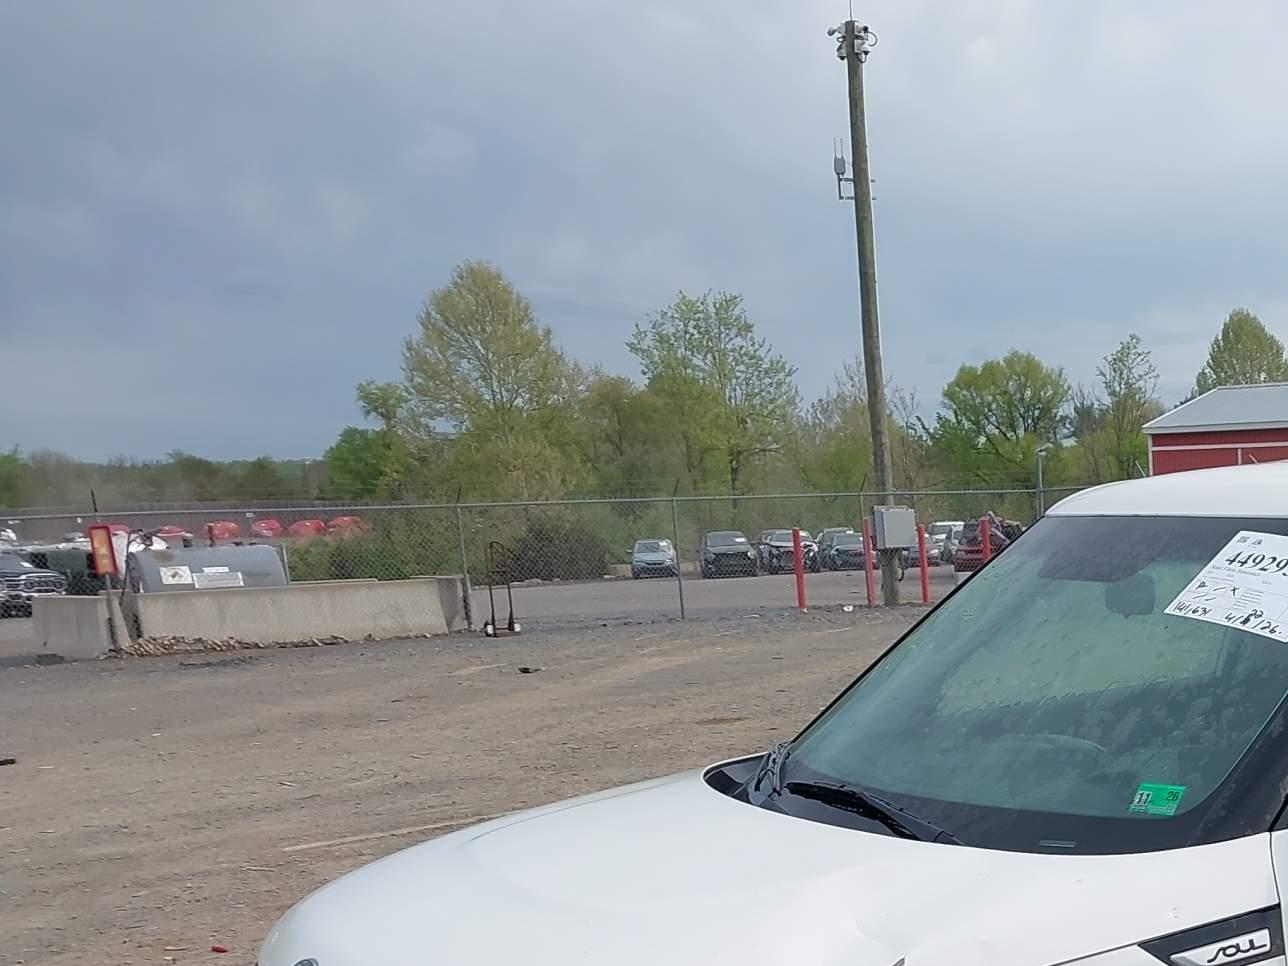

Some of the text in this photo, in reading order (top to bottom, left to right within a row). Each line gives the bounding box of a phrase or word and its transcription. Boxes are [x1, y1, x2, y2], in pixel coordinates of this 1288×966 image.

[1136, 790, 1180, 804] 11 26
[1206, 938, 1267, 964] SOUL
